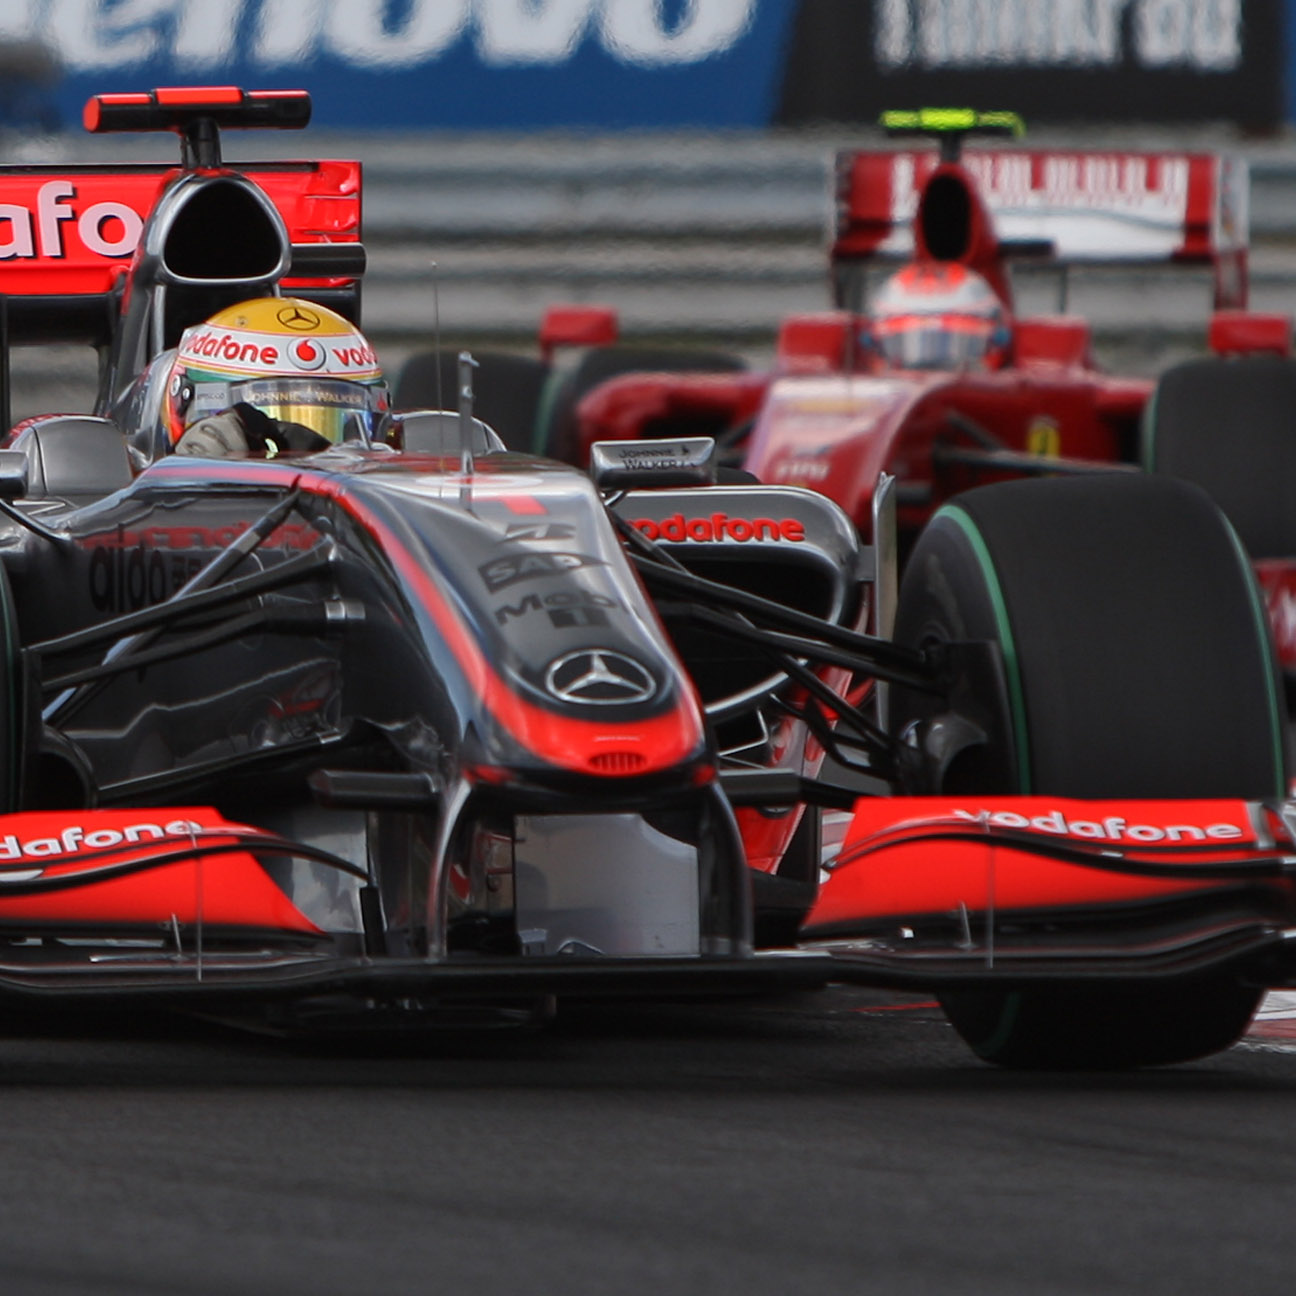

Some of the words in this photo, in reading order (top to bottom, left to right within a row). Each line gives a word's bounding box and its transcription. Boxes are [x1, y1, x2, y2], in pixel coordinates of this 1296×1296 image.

[619, 448, 676, 459] JOHNNIE
[622, 458, 679, 472] WALKER
[625, 511, 806, 543] odafone
[953, 808, 1243, 842] vodafone
